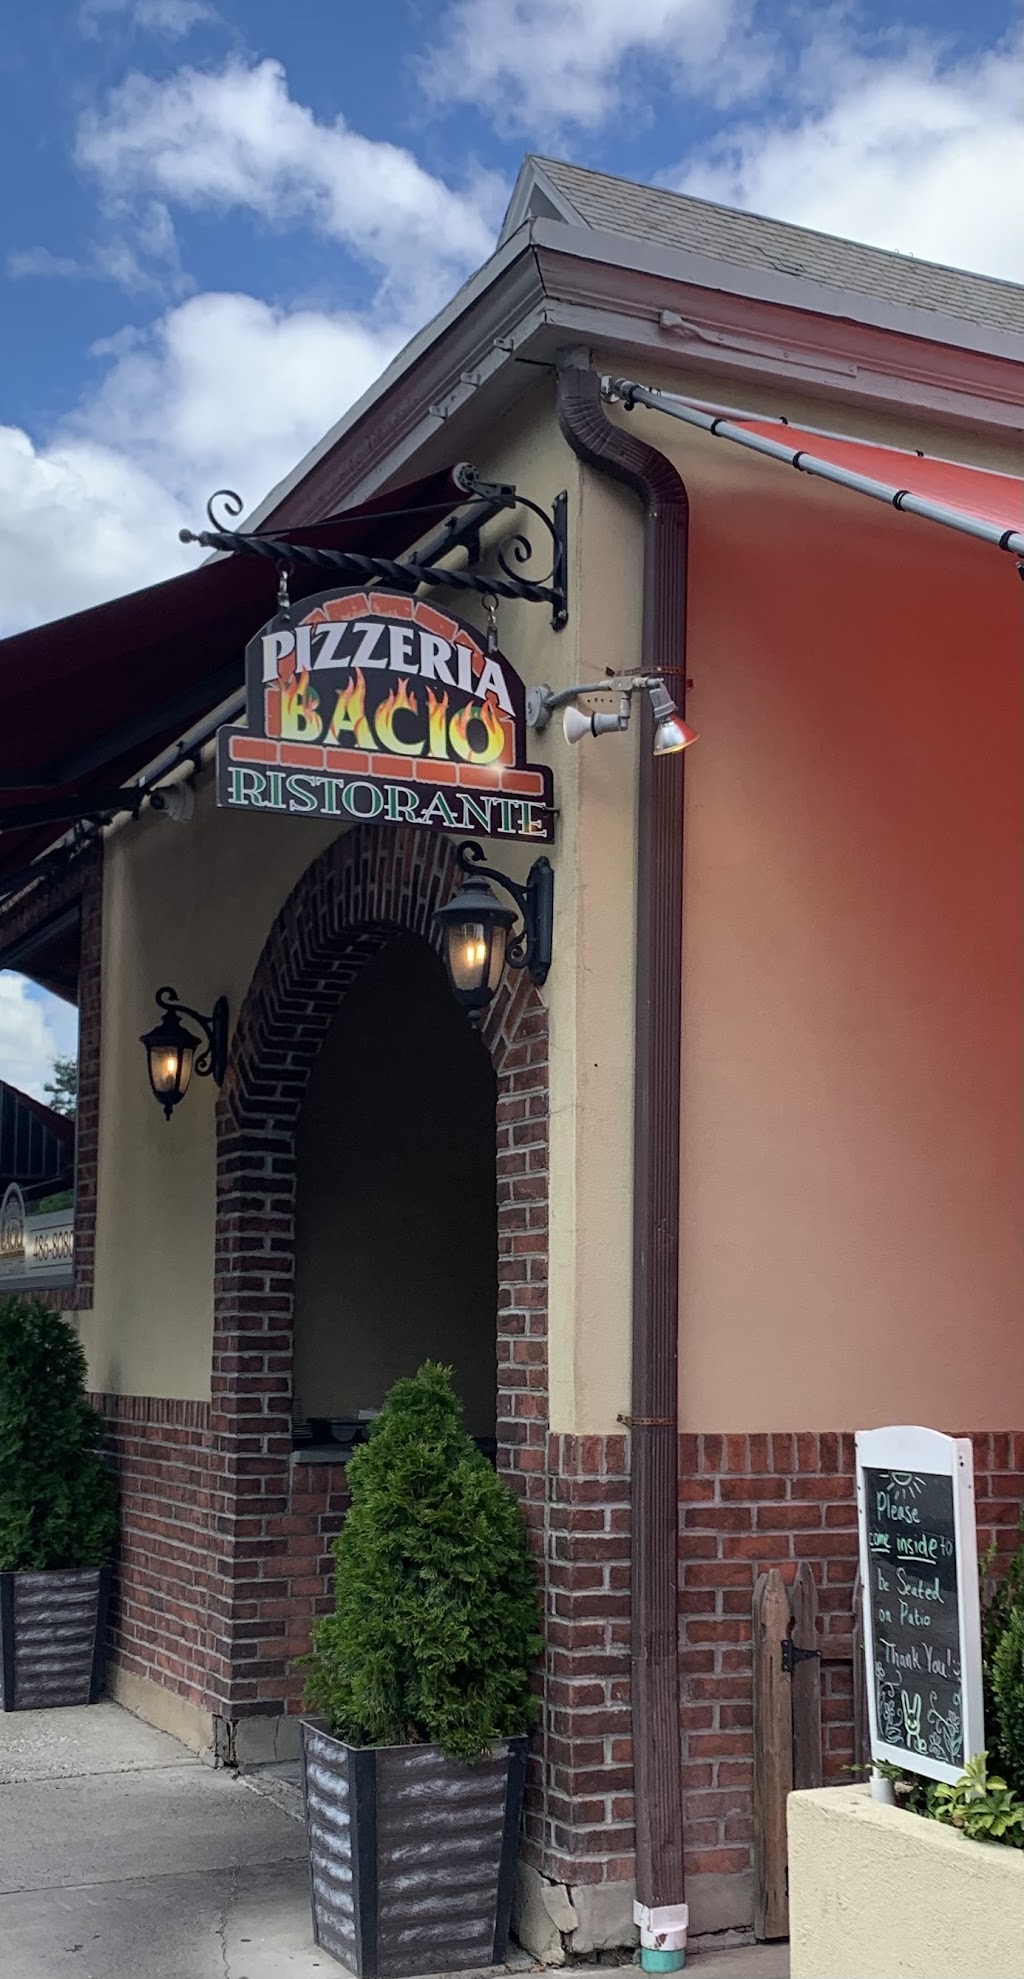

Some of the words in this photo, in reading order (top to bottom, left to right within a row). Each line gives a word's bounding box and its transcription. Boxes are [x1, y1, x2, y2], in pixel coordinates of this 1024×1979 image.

[261, 621, 516, 718] PIZZERIA
[277, 666, 506, 765] BACIO
[227, 766, 548, 838] RISTORANTE
[876, 1491, 921, 1524] Please
[896, 1533, 938, 1559] inside
[940, 1535, 954, 1557] to
[877, 1567, 890, 1592] be
[896, 1567, 945, 1604] Seated
[879, 1609, 892, 1623] on
[898, 1598, 931, 1626] Patio
[879, 1637, 922, 1670] Thank
